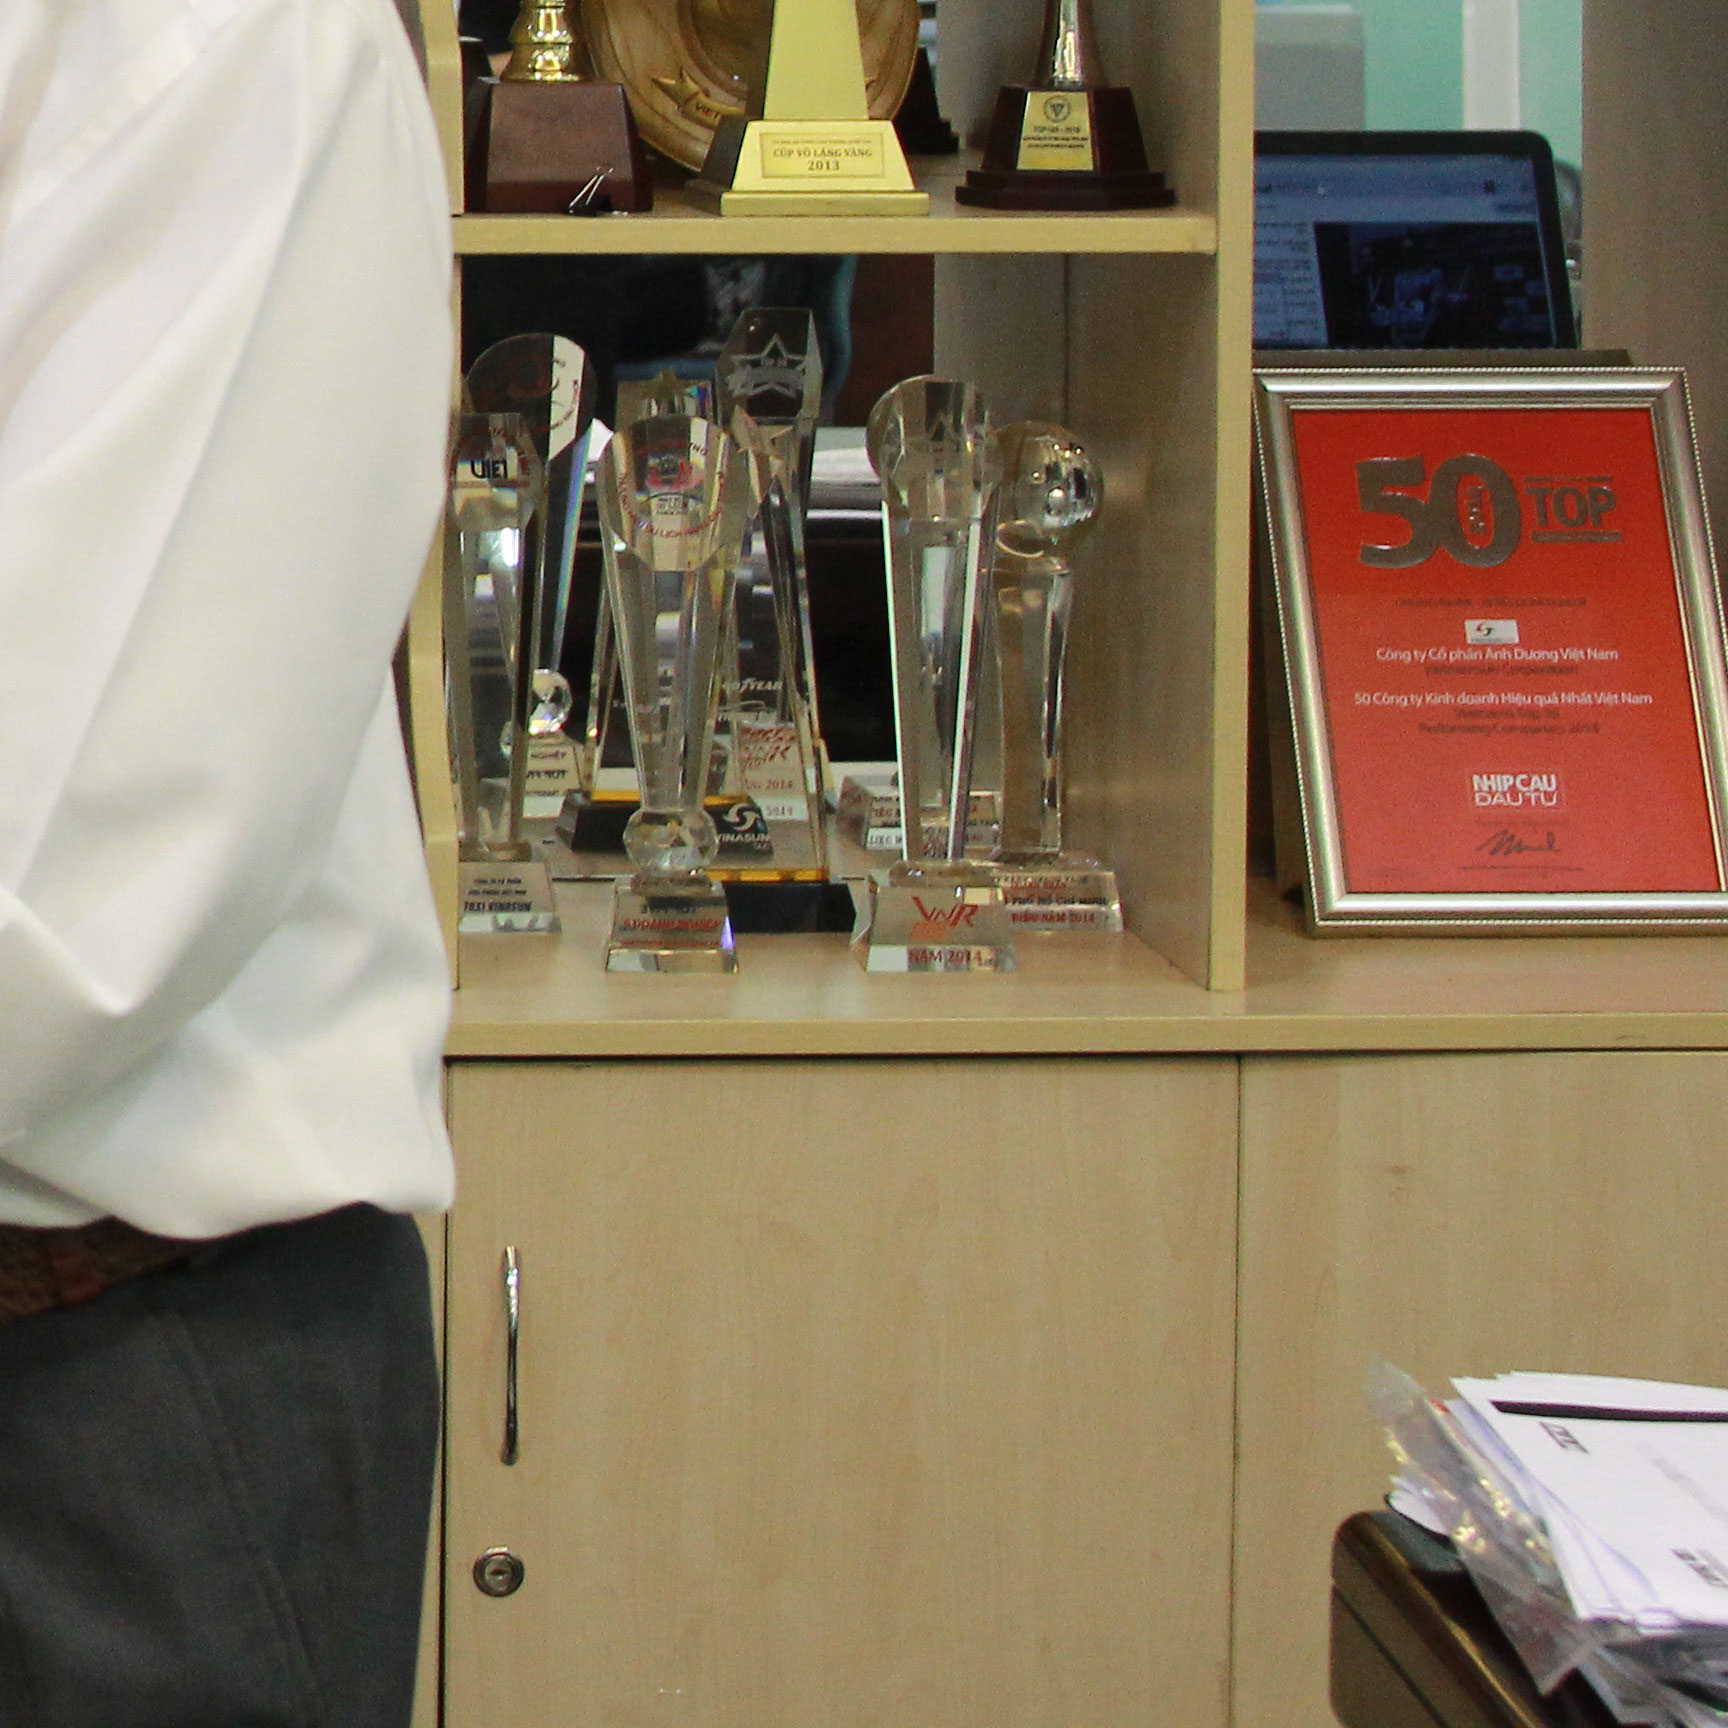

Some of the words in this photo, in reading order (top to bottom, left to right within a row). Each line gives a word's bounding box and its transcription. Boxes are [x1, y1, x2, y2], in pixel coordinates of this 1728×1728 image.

[807, 160, 840, 172] 2013
[1354, 453, 1522, 569] 50
[1523, 485, 1618, 527] TOP
[1376, 648, 1412, 662] Công
[1413, 649, 1427, 663] ty
[1560, 648, 1585, 662] Việt
[1588, 648, 1619, 660] Nam
[1354, 693, 1372, 705] 50
[1373, 693, 1409, 707] Công
[1410, 693, 1423, 707] ty
[1425, 692, 1453, 705] Kinh
[1457, 692, 1498, 705] doanh
[1594, 692, 1619, 707] Việt
[1621, 692, 1654, 705] Nam
